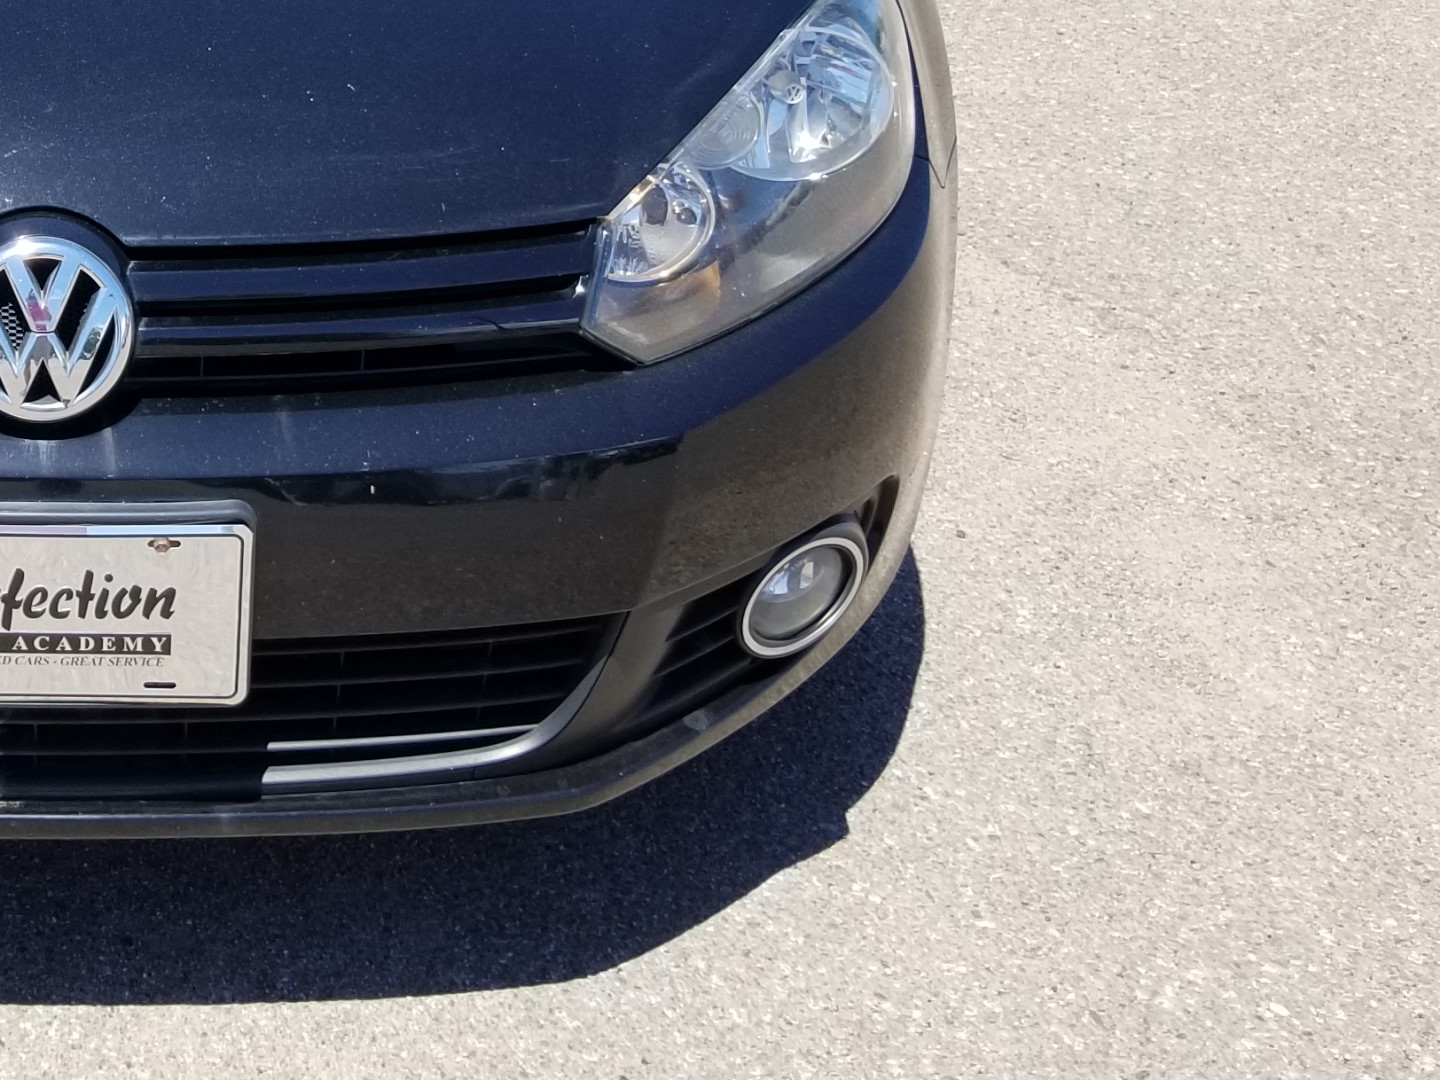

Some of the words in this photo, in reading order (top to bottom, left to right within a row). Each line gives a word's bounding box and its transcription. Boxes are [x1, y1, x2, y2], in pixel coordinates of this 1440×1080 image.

[11, 635, 167, 653] ACADEMY
[14, 656, 50, 666] CARS
[60, 656, 105, 667] GREAT
[108, 657, 165, 668] SERVICE
